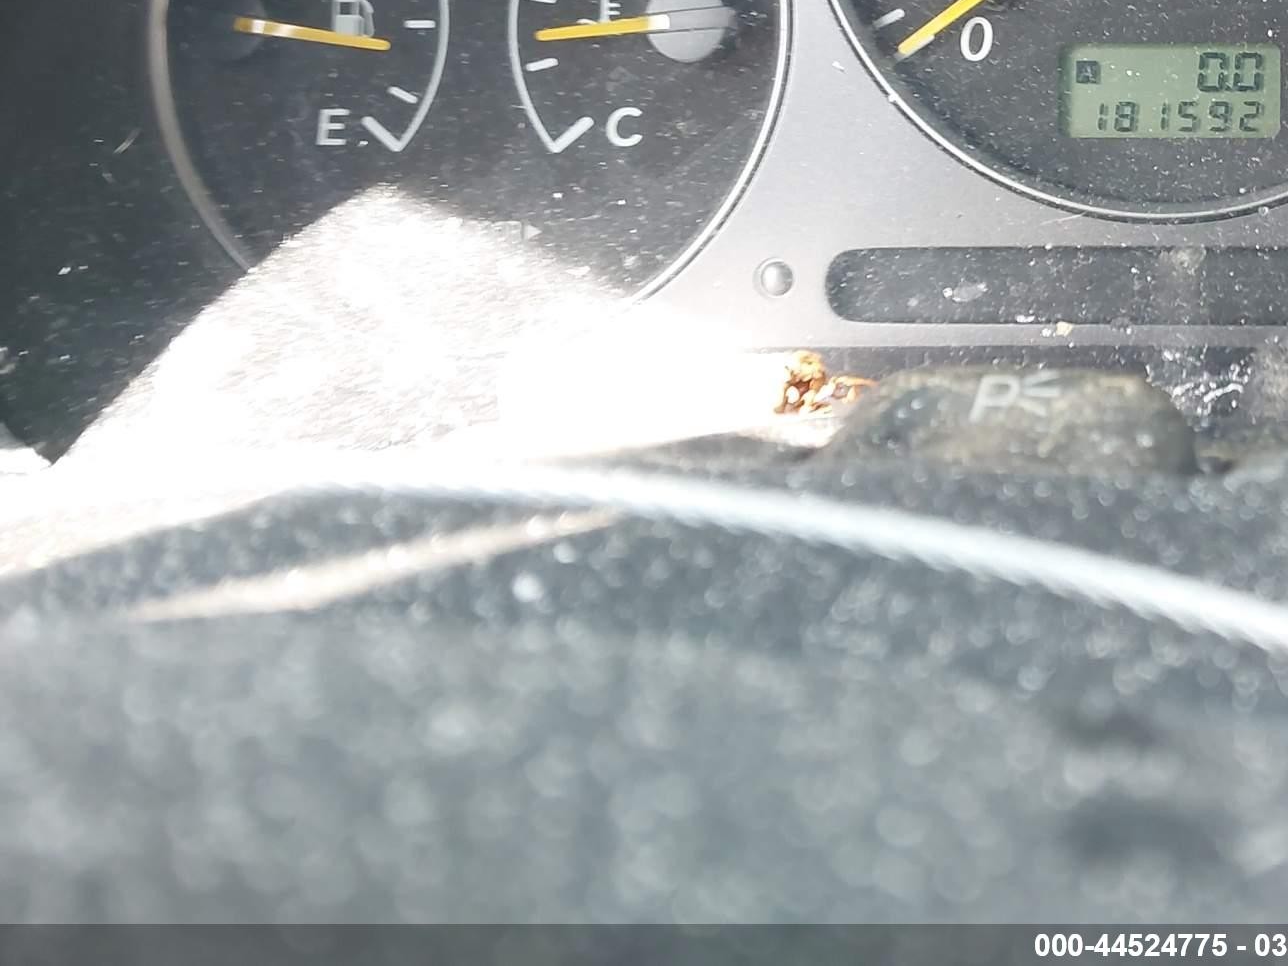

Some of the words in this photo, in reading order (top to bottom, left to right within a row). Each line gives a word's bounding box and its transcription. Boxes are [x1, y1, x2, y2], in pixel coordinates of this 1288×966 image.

[960, 17, 994, 62] 0
[317, 109, 350, 146] E
[605, 107, 643, 147] C
[1097, 100, 1264, 133] 181592
